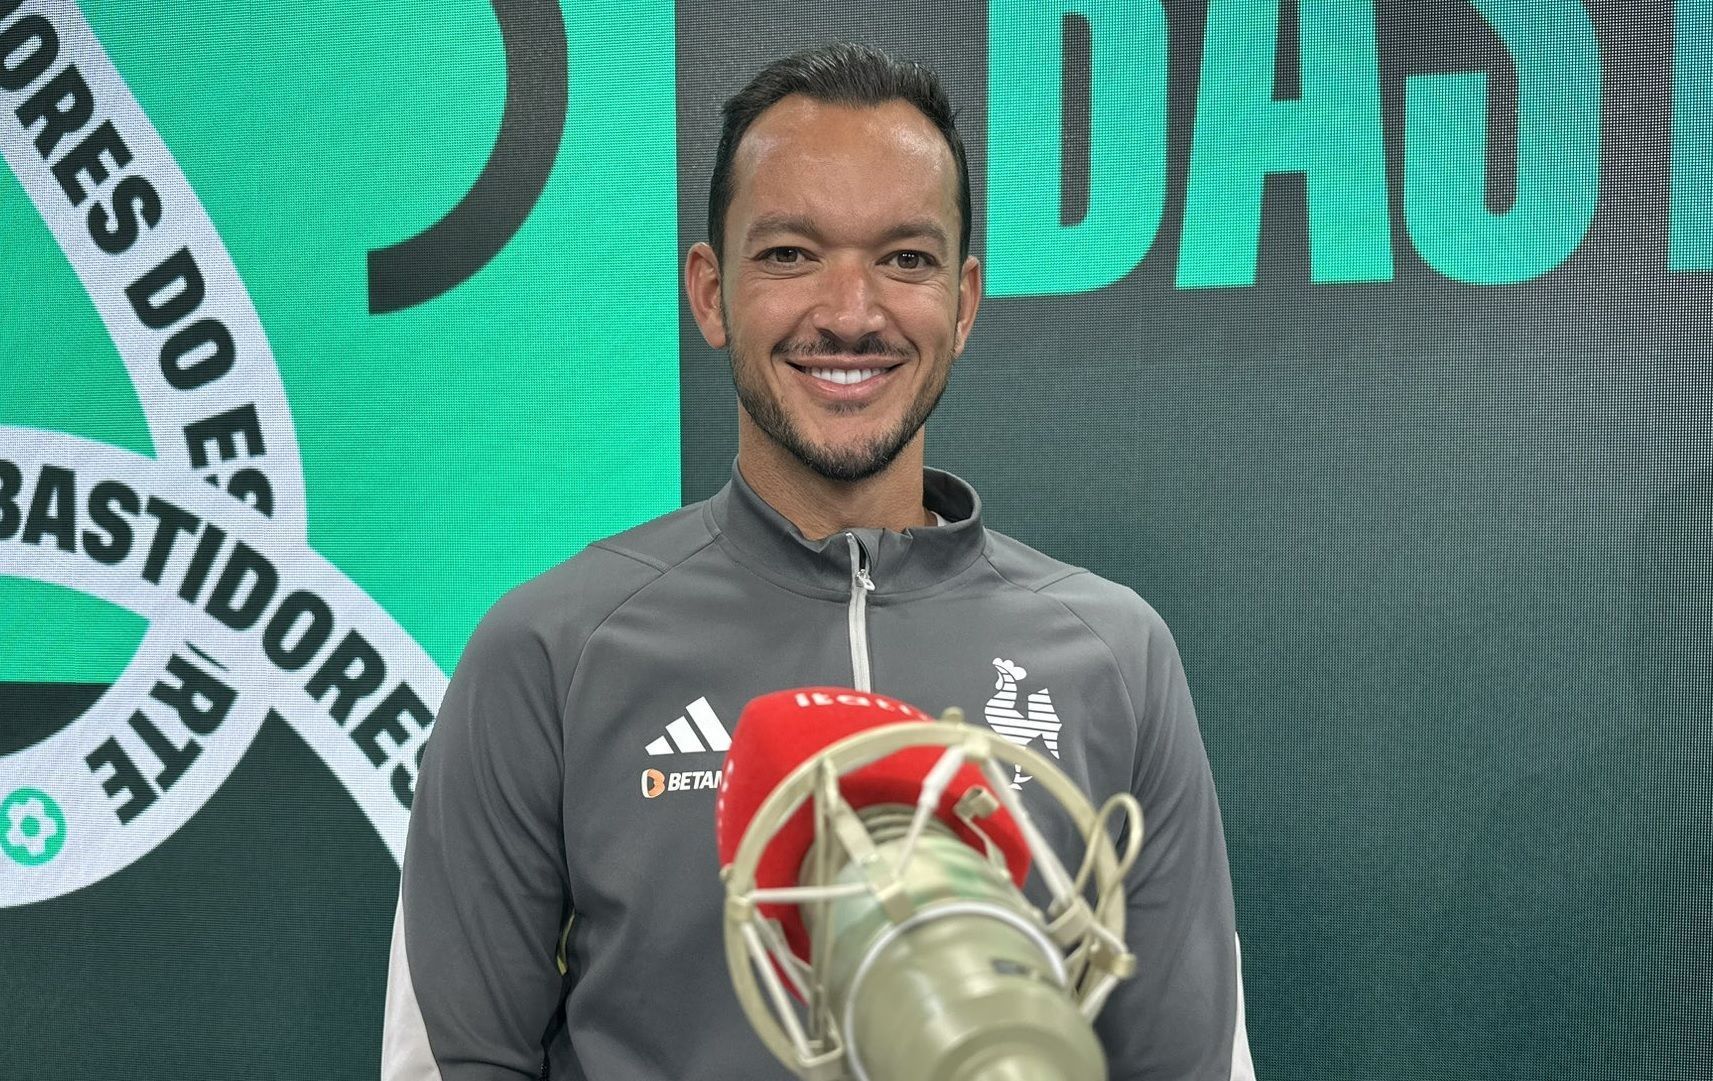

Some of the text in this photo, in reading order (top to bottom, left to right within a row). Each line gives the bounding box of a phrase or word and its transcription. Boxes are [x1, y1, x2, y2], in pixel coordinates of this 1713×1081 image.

[0, 0, 162, 255] ORES
[125, 247, 236, 390] DO
[985, 0, 1713, 298] BAS
[85, 641, 239, 825] RTE
